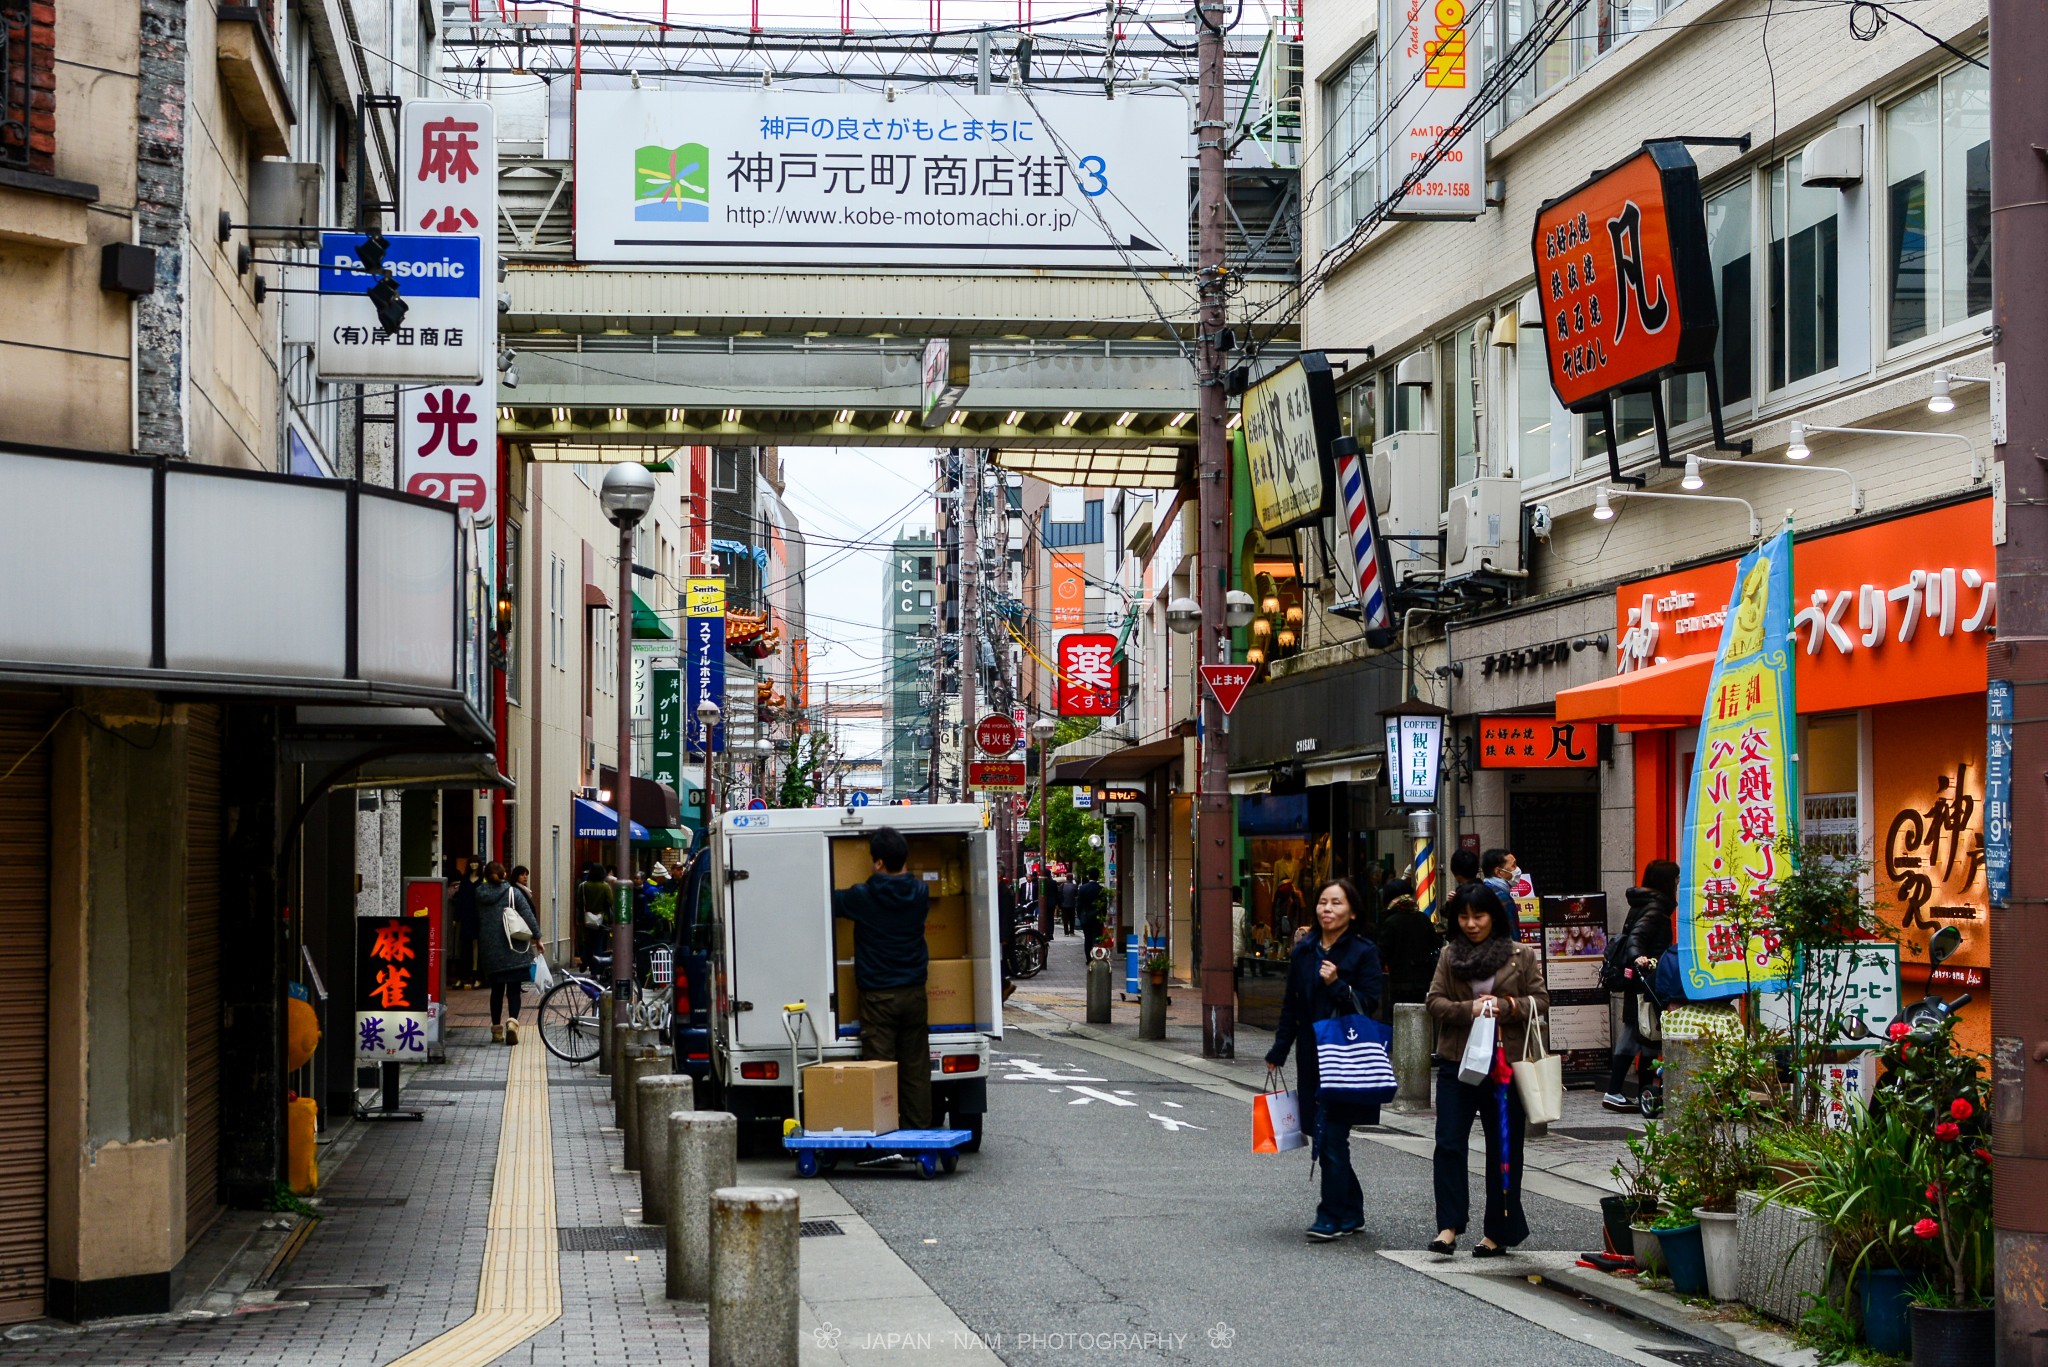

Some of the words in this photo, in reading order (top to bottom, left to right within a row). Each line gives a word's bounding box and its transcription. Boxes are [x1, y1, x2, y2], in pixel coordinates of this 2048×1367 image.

[760, 114, 1033, 143] 神戸の良さがもとまちに
[726, 203, 1079, 232] http://www.kobe-motomachi.or.jp/
[1545, 210, 1591, 260] お好み焼
[334, 255, 466, 280] Paasonic
[1550, 252, 1596, 302] 鉄板焼
[1606, 199, 1670, 347] 凡
[1555, 293, 1602, 341] 明石焼
[1561, 336, 1608, 382] そばめし
[693, 585, 719, 593] Smile
[901, 559, 913, 612] KCC
[693, 605, 719, 613] Hotel
[1066, 643, 1112, 690] 薬
[1211, 674, 1245, 686] 止まれ
[633, 657, 646, 717] ワンダフル
[670, 678, 680, 704] 洋食
[1988, 687, 2008, 698] 中央区
[1403, 720, 1438, 730] COFFEE
[1484, 727, 1535, 741] お好み焼
[981, 732, 1011, 746] 消火栓
[1485, 744, 1535, 757] 鉄板焼
[1543, 722, 1588, 763] 凡
[1411, 731, 1428, 787] 観音屋
[1510, 774, 1527, 785] 2F
[1404, 789, 1434, 798] CHEESE
[579, 828, 606, 836] SITTING
[1992, 891, 1998, 901] 9
[368, 918, 416, 1009] 麻雀
[358, 1016, 425, 1052] 紫光
